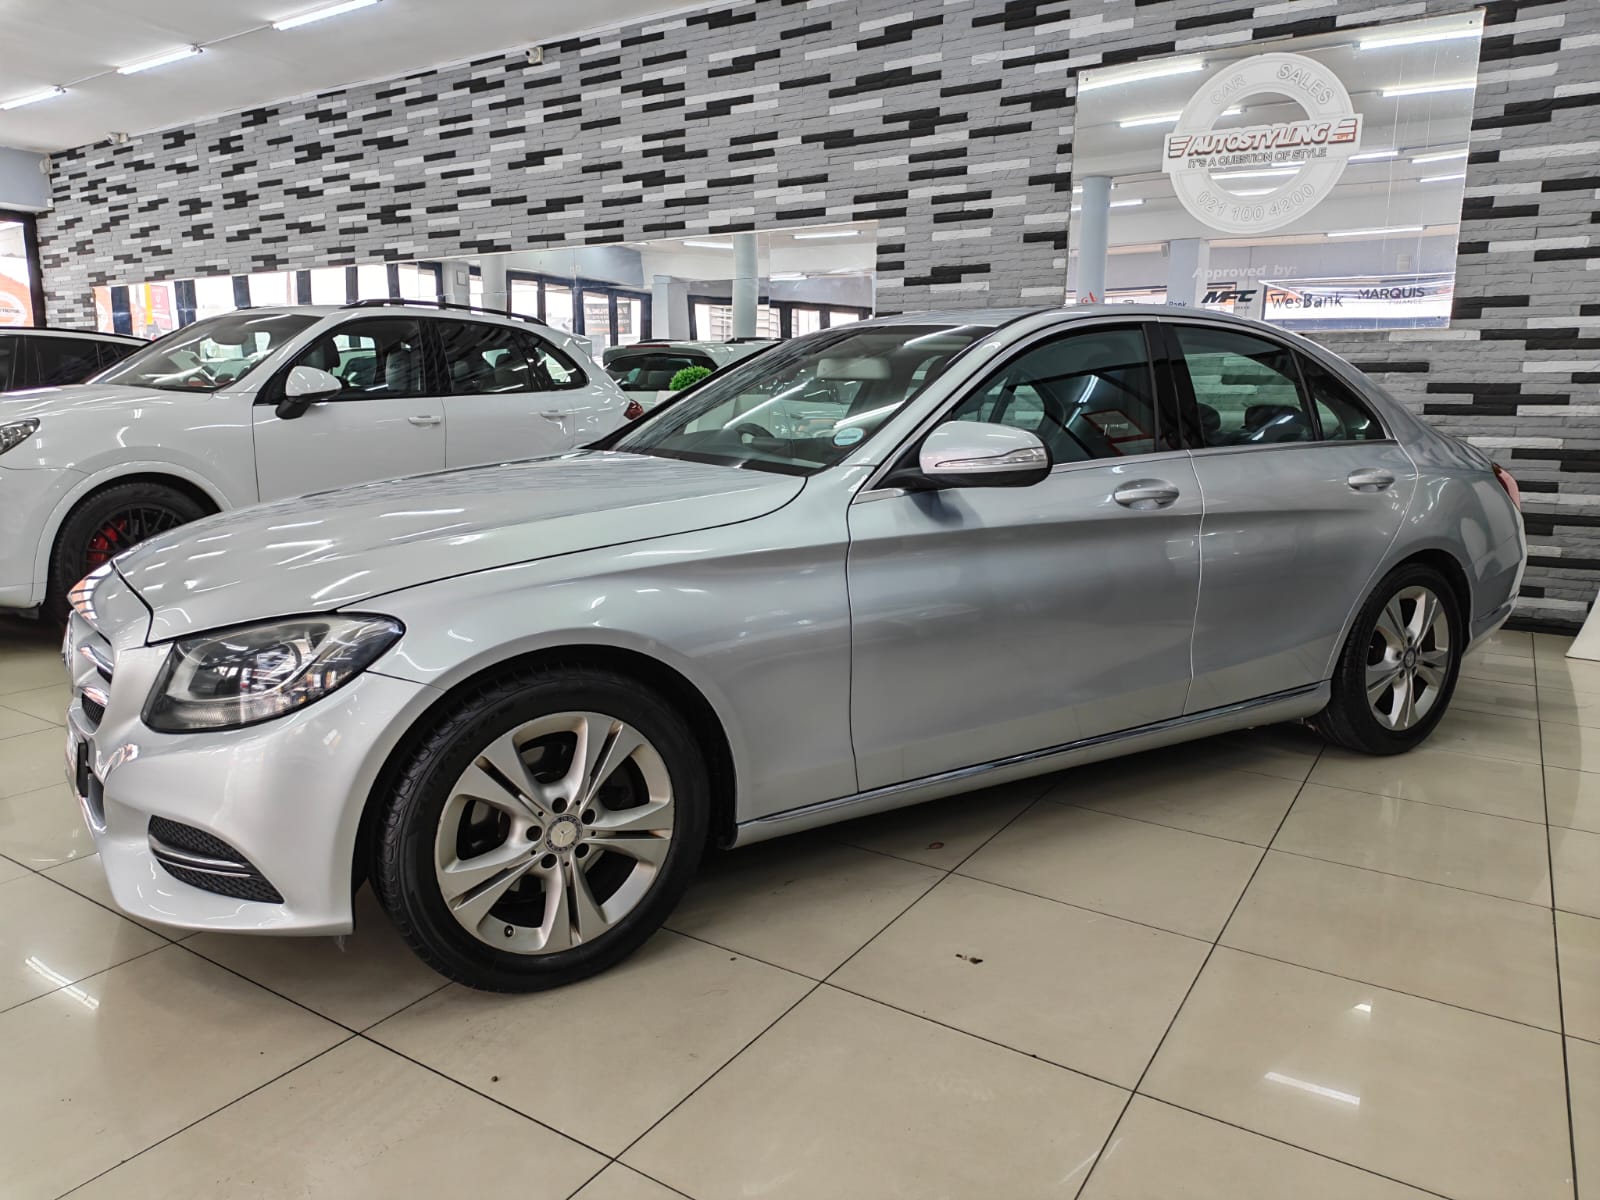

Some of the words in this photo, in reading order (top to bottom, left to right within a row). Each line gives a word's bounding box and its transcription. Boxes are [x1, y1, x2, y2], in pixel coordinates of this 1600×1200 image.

[1211, 74, 1248, 104] CAR
[1277, 64, 1335, 105] SALES
[1187, 122, 1330, 156] AUTOSTYLING
[1208, 157, 1217, 167] A
[1217, 152, 1273, 166] QUESTION
[1274, 150, 1291, 162] OF
[1292, 147, 1327, 160] STYLE
[1198, 191, 1227, 216] 021
[1232, 205, 1265, 222] 100
[1269, 184, 1315, 216] 4200
[1192, 265, 1267, 282] Approved
[1273, 264, 1297, 277] by:
[1201, 290, 1257, 304] MFC
[1271, 292, 1344, 310] WesBank
[1358, 287, 1425, 300] MARQUIS
